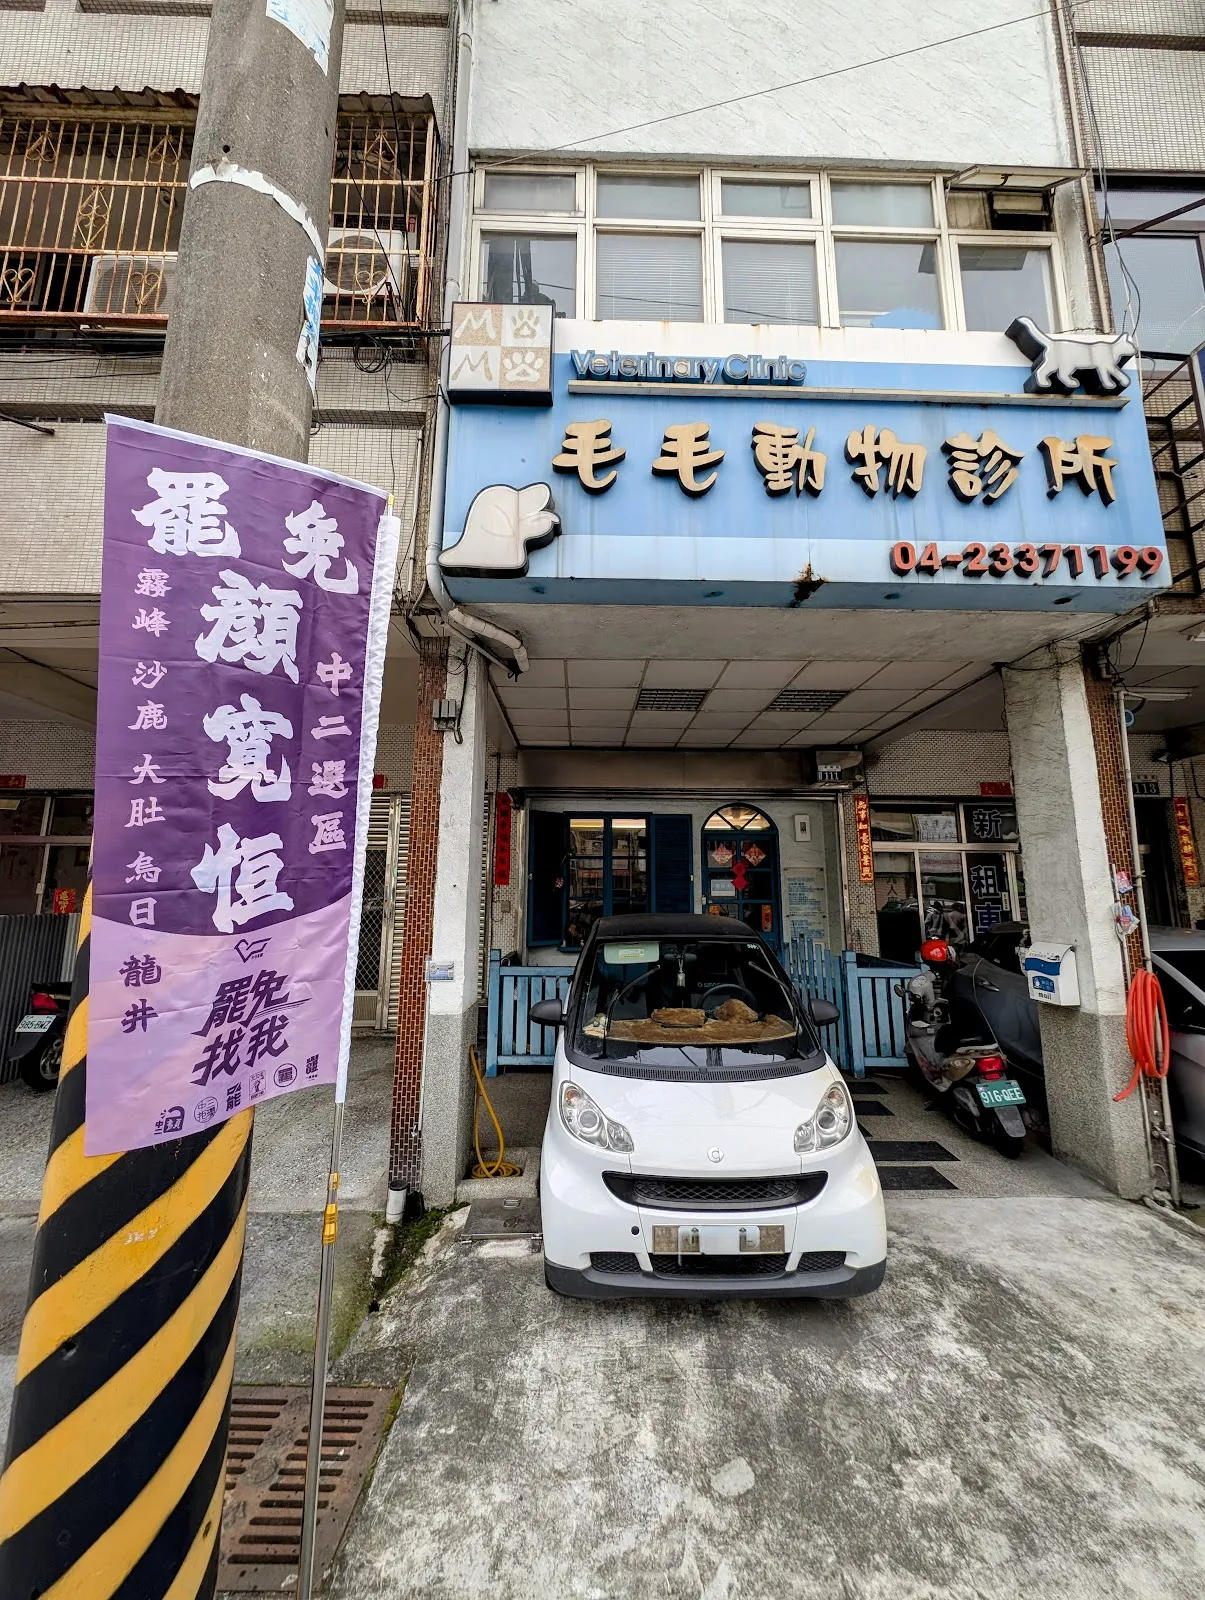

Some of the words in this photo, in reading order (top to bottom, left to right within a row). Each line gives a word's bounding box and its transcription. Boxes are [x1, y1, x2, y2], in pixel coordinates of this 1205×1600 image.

[454, 308, 497, 340] M
[452, 350, 493, 381] M
[570, 350, 719, 384] Veterinary
[722, 354, 807, 386] Clinic
[552, 419, 1118, 506] 毛毛動物診所
[890, 542, 1163, 580] 04-23371199
[190, 569, 303, 933] 顏寬恒
[307, 652, 353, 855] 中二選區
[1134, 783, 1157, 794] 113
[190, 969, 290, 1036] 罷免
[1038, 992, 1052, 1000] mail
[190, 1015, 290, 1086] 找我
